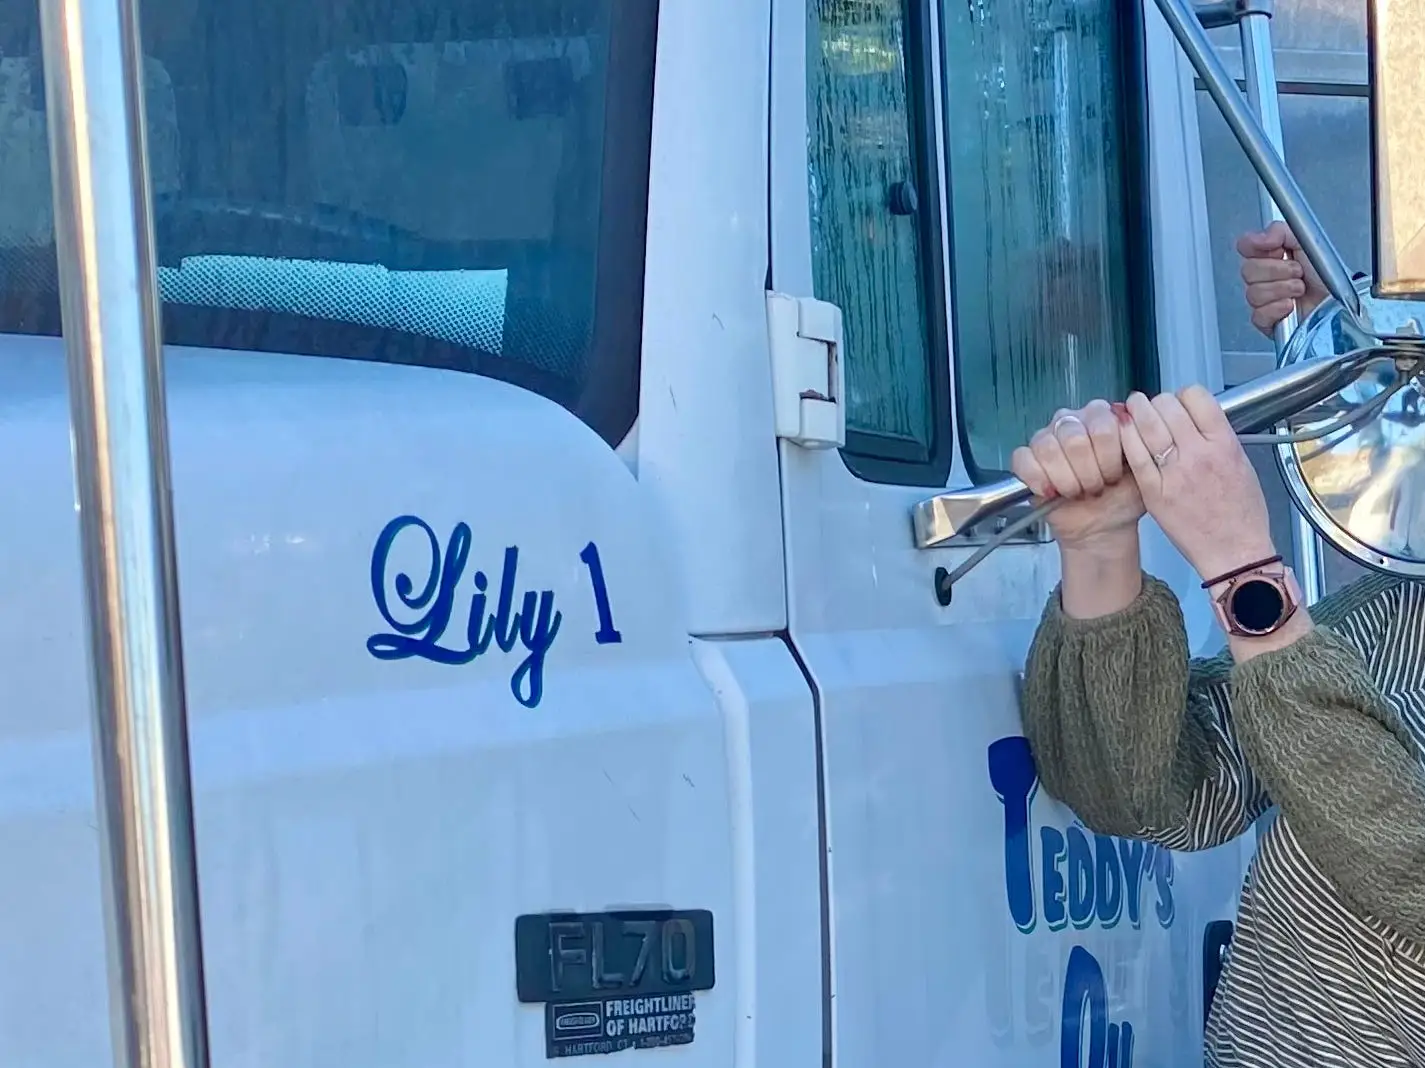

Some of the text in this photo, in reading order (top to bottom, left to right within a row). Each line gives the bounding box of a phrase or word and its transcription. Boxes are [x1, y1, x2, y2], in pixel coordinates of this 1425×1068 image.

[366, 515, 622, 708] Lily 1
[548, 919, 696, 992] FL70
[606, 1019, 625, 1037] OF
